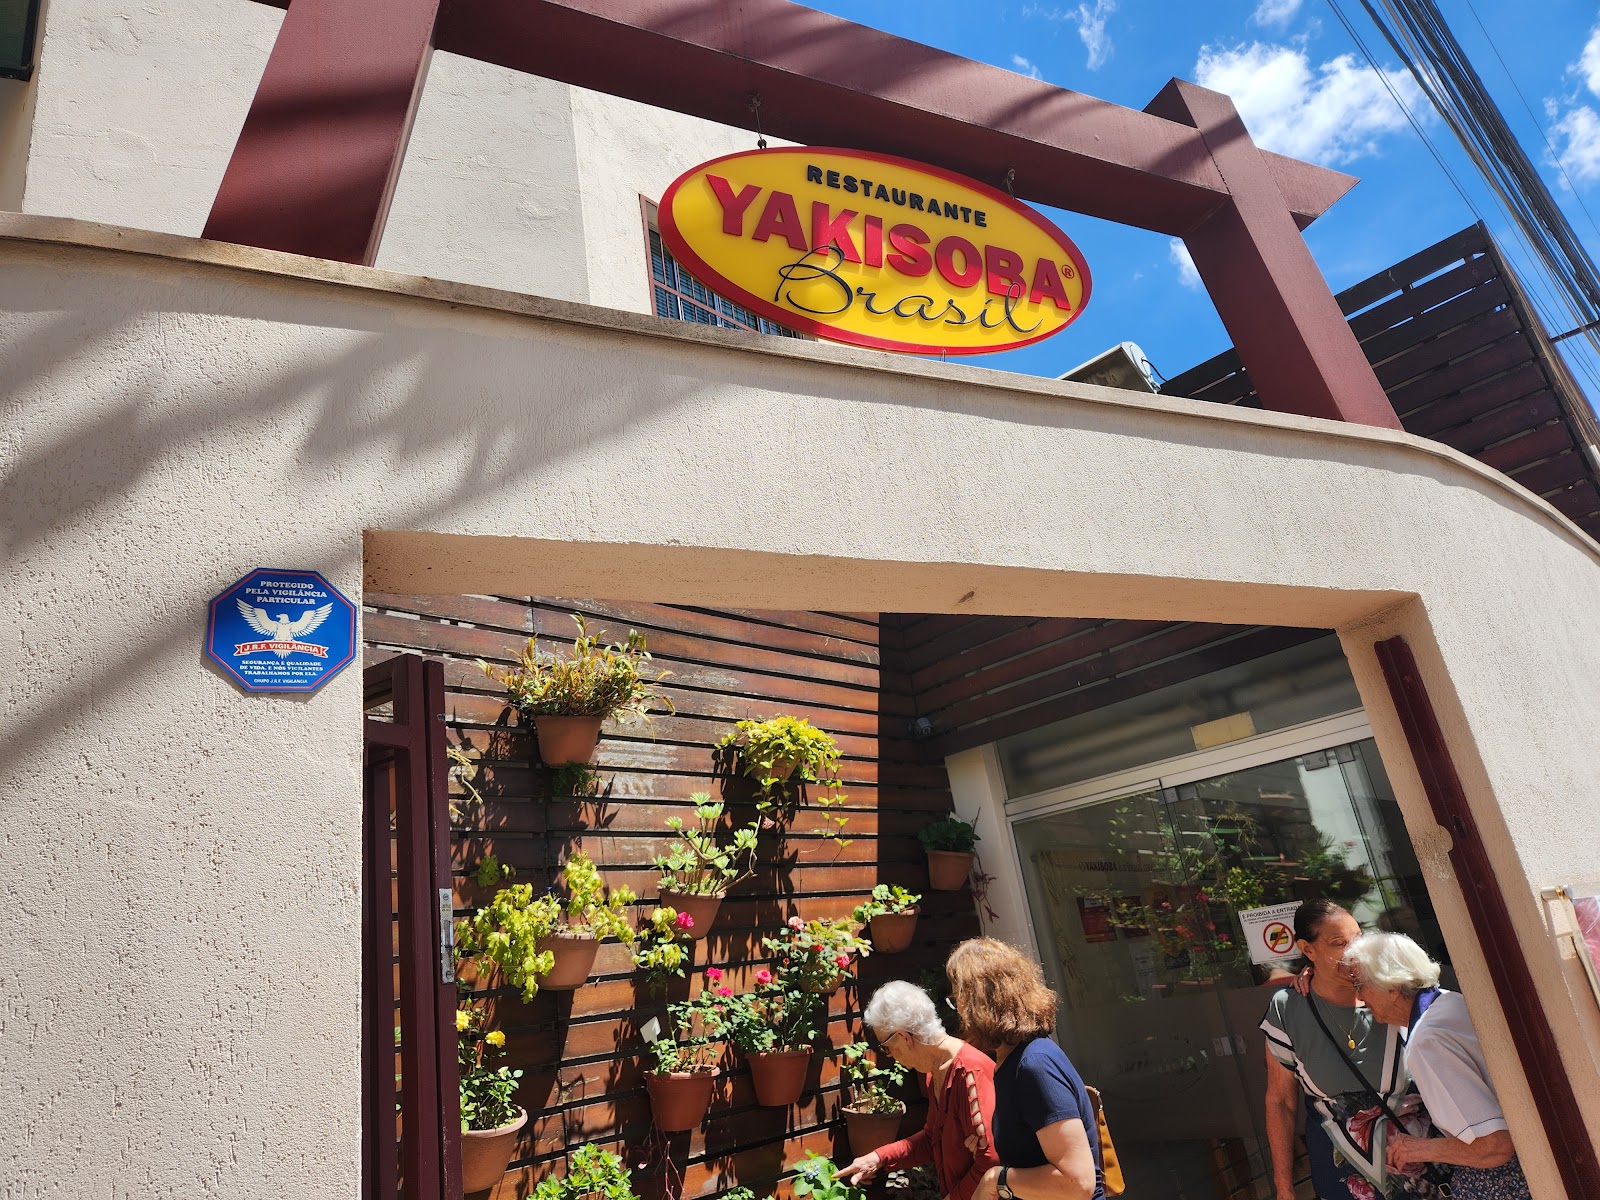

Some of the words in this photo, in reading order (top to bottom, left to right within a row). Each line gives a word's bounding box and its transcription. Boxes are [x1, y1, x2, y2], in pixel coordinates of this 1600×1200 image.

[806, 164, 988, 228] RESTAURANTE
[705, 173, 1072, 312] YAKISOBA
[774, 245, 1044, 333] Brasil
[260, 580, 315, 589] PROTEGIDO
[272, 589, 328, 598] VIGILÂNCIA
[256, 596, 316, 605] PARTICULAR
[268, 643, 319, 653] VIGILÂNCIA
[1085, 861, 1118, 872] YAKISOBA
[1246, 910, 1272, 918] PROIBIDA
